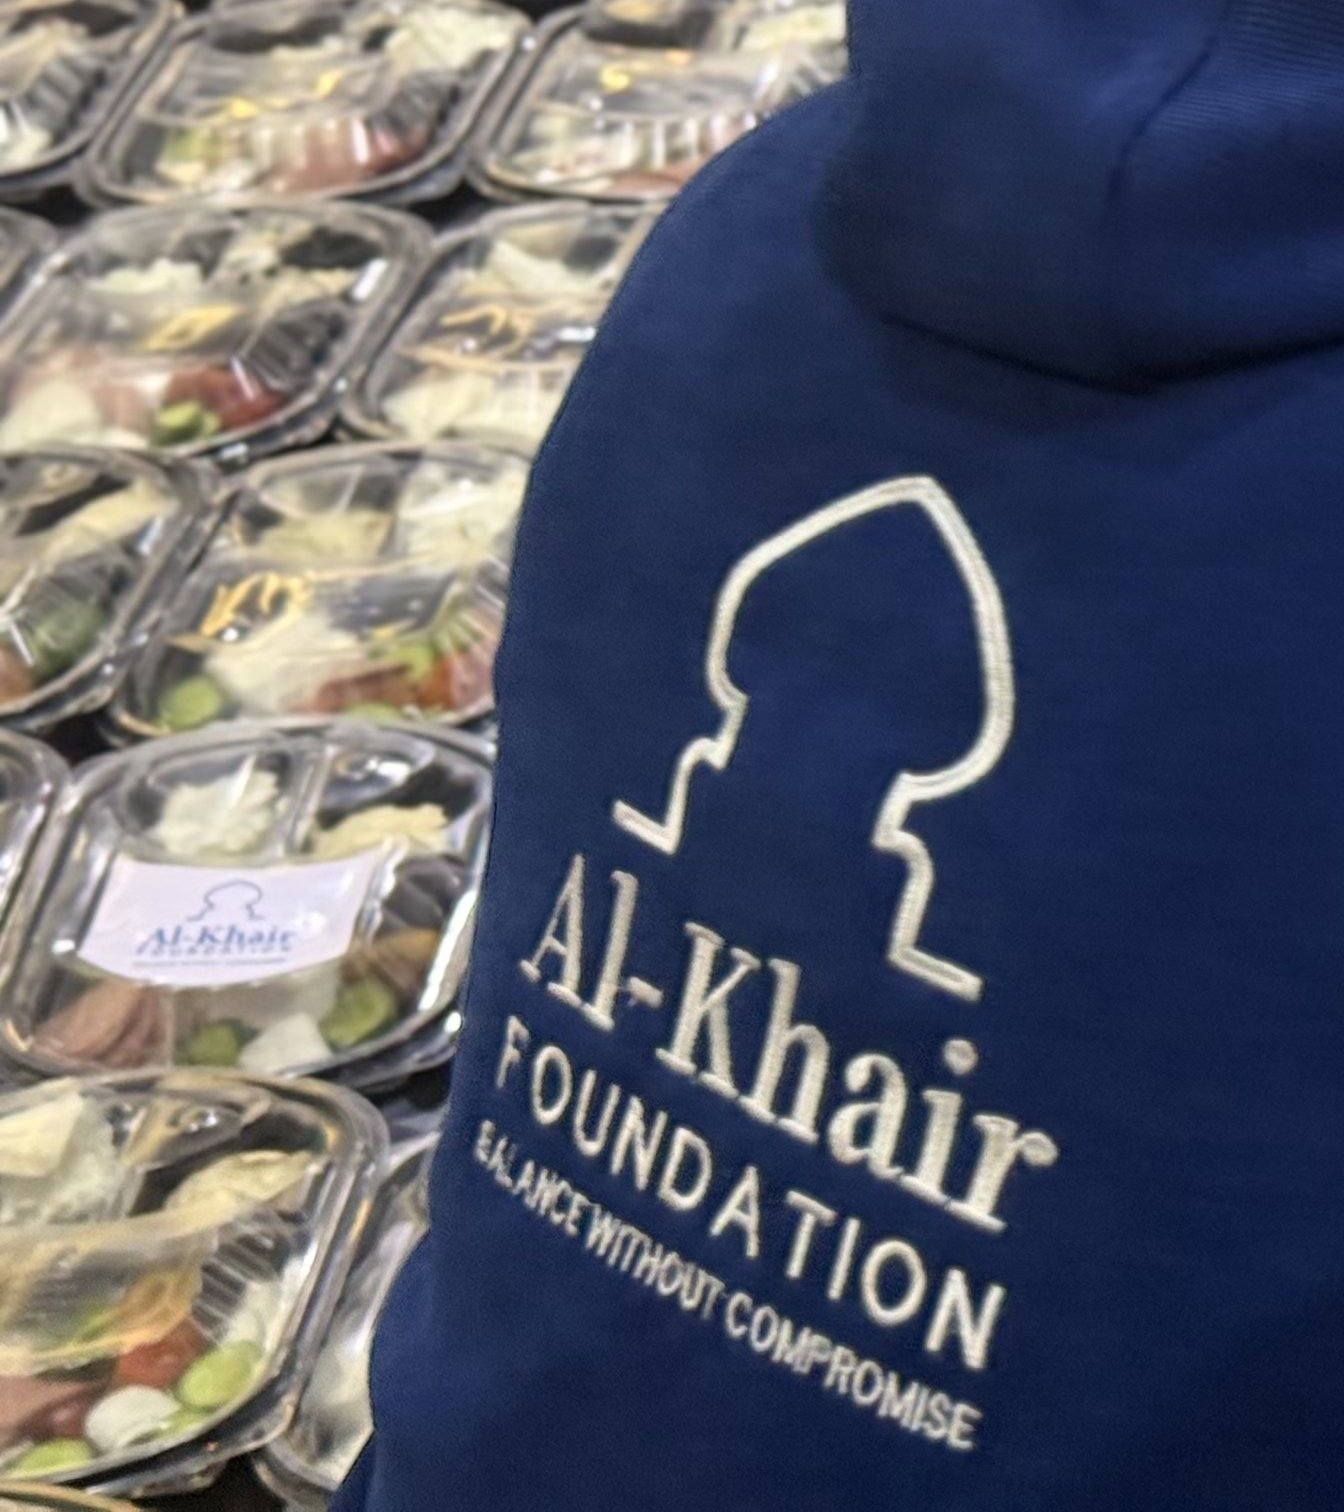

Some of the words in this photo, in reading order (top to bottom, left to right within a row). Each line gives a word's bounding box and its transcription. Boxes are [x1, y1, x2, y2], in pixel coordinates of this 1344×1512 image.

[497, 1015, 1005, 1369] FOUNDATION
[520, 854, 1059, 1231] Al-Khair
[473, 1119, 591, 1236] BALANCE
[586, 1202, 725, 1319] WITHOUT
[725, 1291, 983, 1450] COMPROMISE
